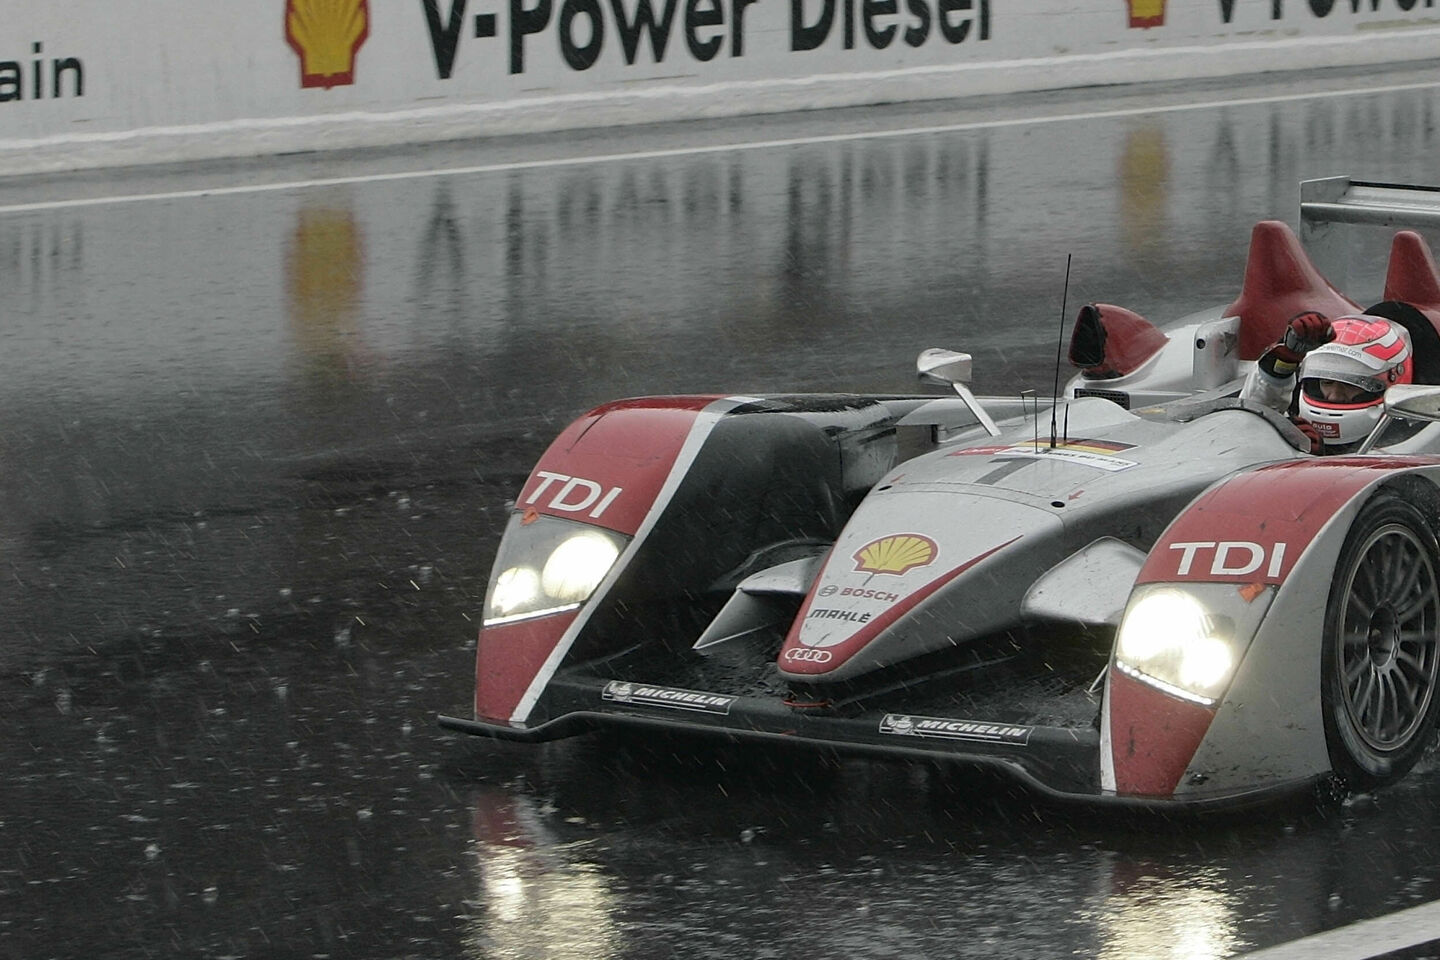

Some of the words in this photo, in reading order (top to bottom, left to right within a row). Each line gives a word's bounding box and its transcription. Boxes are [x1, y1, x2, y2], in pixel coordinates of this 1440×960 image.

[0, 41, 83, 102] ain
[526, 471, 623, 518] TDI
[1169, 541, 1287, 578] TDI
[839, 587, 900, 603] BOSCH
[809, 608, 872, 624] MAHLE
[634, 687, 737, 707] MICHELIN
[916, 719, 1028, 738] MICHELIN
